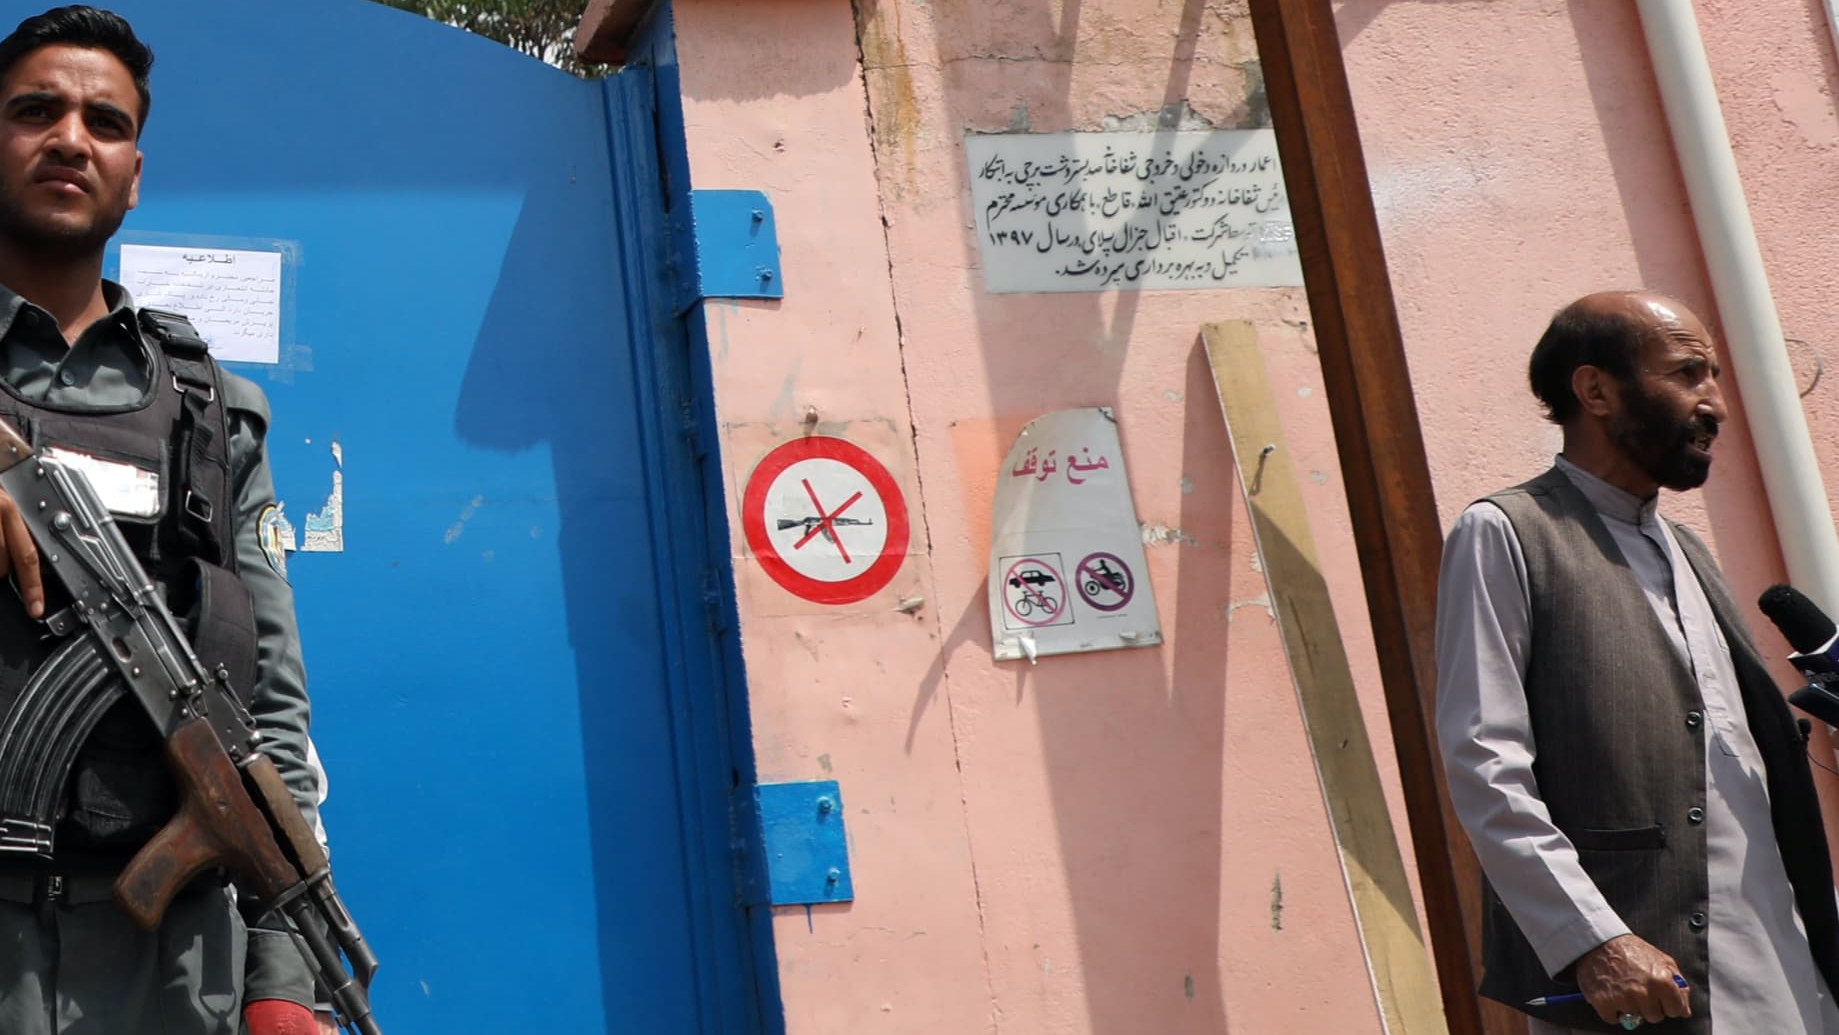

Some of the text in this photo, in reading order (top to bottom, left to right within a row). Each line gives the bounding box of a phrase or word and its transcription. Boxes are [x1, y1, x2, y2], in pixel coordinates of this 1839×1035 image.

[989, 229, 1034, 247] ۱۳۹۷
[1011, 445, 1110, 485] منع توقف
